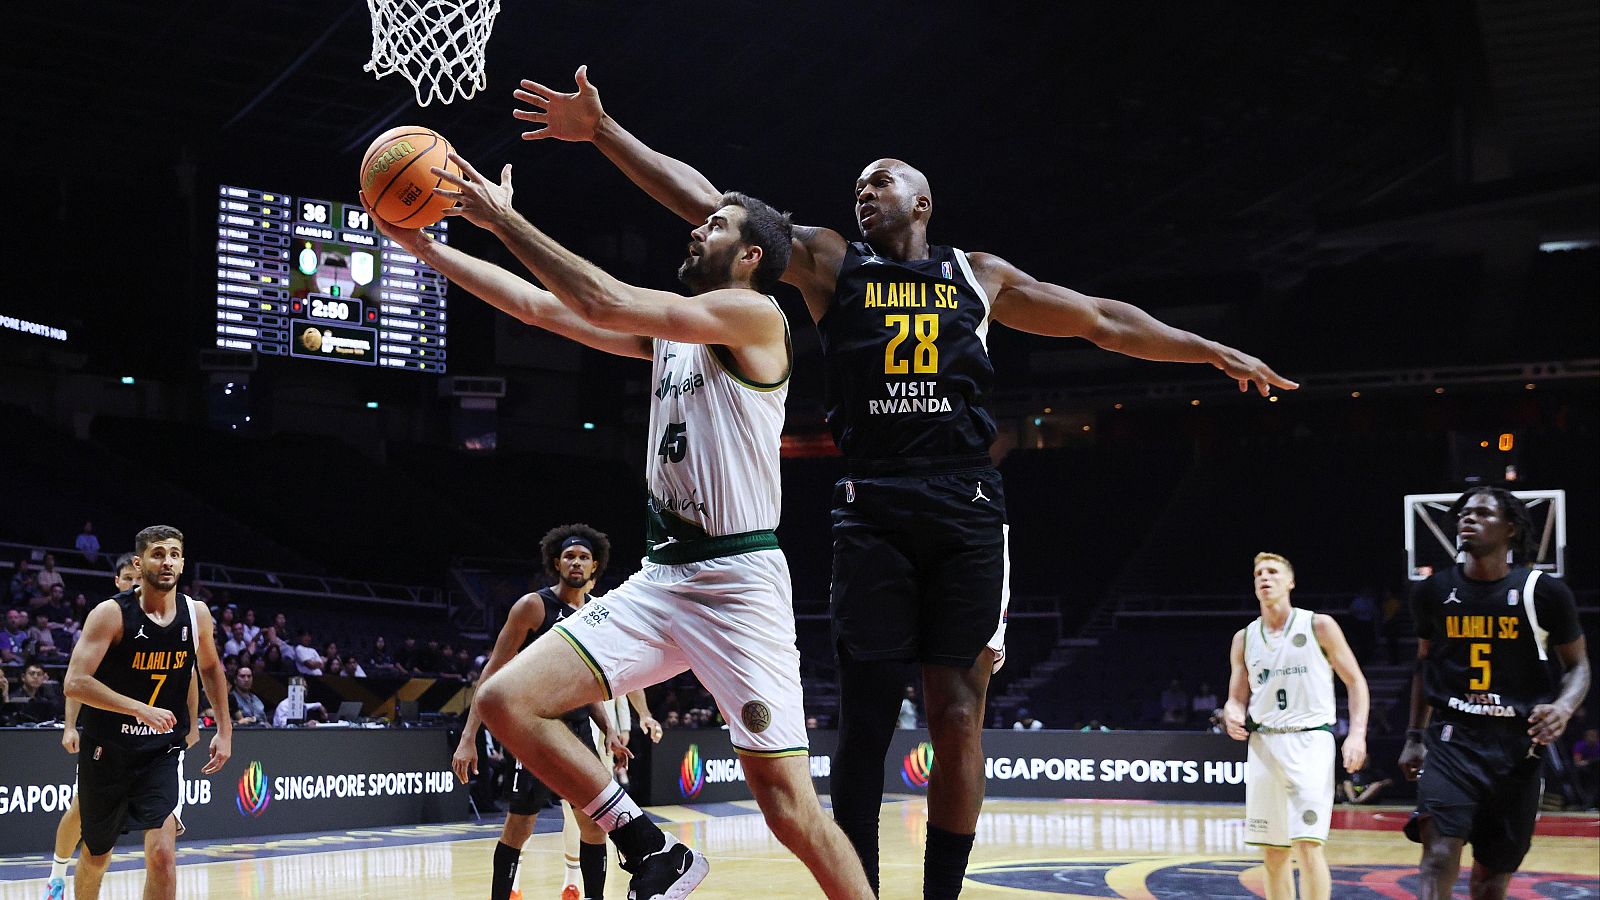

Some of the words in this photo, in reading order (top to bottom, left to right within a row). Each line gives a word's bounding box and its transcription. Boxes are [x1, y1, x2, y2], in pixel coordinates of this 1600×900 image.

[401, 185, 423, 207] FIBA
[303, 203, 327, 223] 36
[348, 211, 369, 230] 51
[864, 282, 927, 309] ALAHLI
[934, 283, 958, 309] SC
[312, 300, 349, 320] 2:50
[884, 313, 939, 375] 28
[886, 381, 937, 397] VISIT
[869, 397, 953, 415] RWANDA
[657, 422, 687, 464] 45
[1446, 615, 1493, 638] ALAHLI
[1498, 616, 1519, 639] SC
[132, 651, 171, 670] ALAHLI
[173, 650, 188, 670] SC
[1469, 643, 1492, 690] 5
[148, 673, 167, 707] 7
[1276, 688, 1288, 711] 9
[1464, 692, 1501, 705] VISIT
[1447, 696, 1517, 717] RWANDA
[704, 758, 746, 783] SINGA
[1099, 759, 1199, 784] SPORTS
[274, 774, 366, 802] SINGAPORE
[367, 772, 424, 797] SPORTS
[425, 770, 454, 794] HUB
